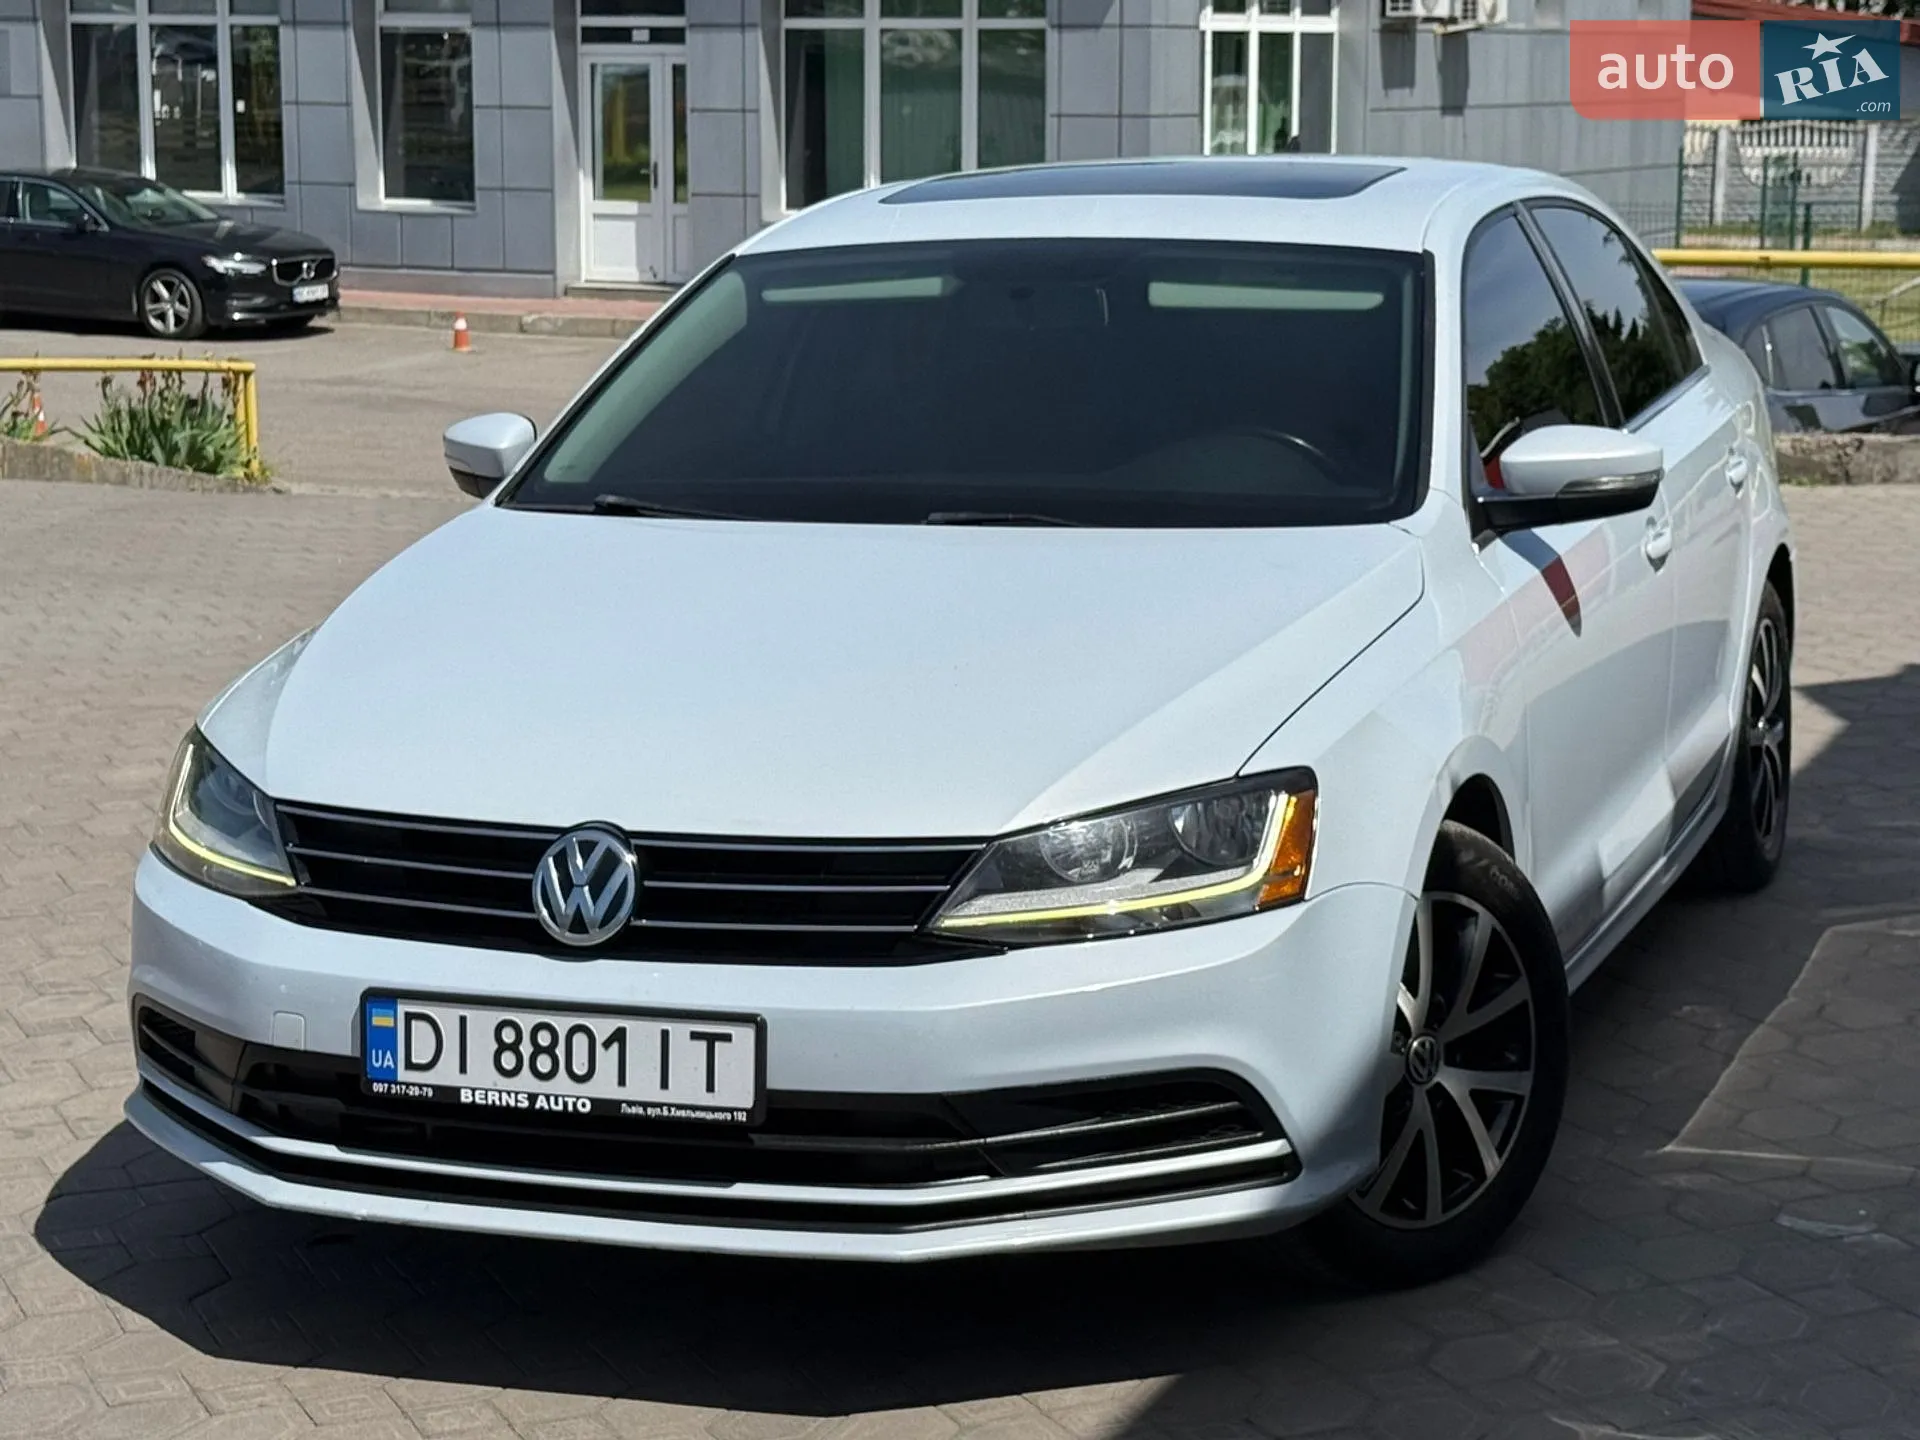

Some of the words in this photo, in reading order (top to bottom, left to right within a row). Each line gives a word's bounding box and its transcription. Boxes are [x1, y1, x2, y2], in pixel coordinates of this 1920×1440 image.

[371, 1049, 395, 1069] UA
[403, 1010, 468, 1075] DI
[493, 1018, 628, 1088] 8801
[659, 1028, 733, 1093] IT
[460, 1088, 530, 1109] BERNS
[534, 1094, 592, 1114] AUTO
